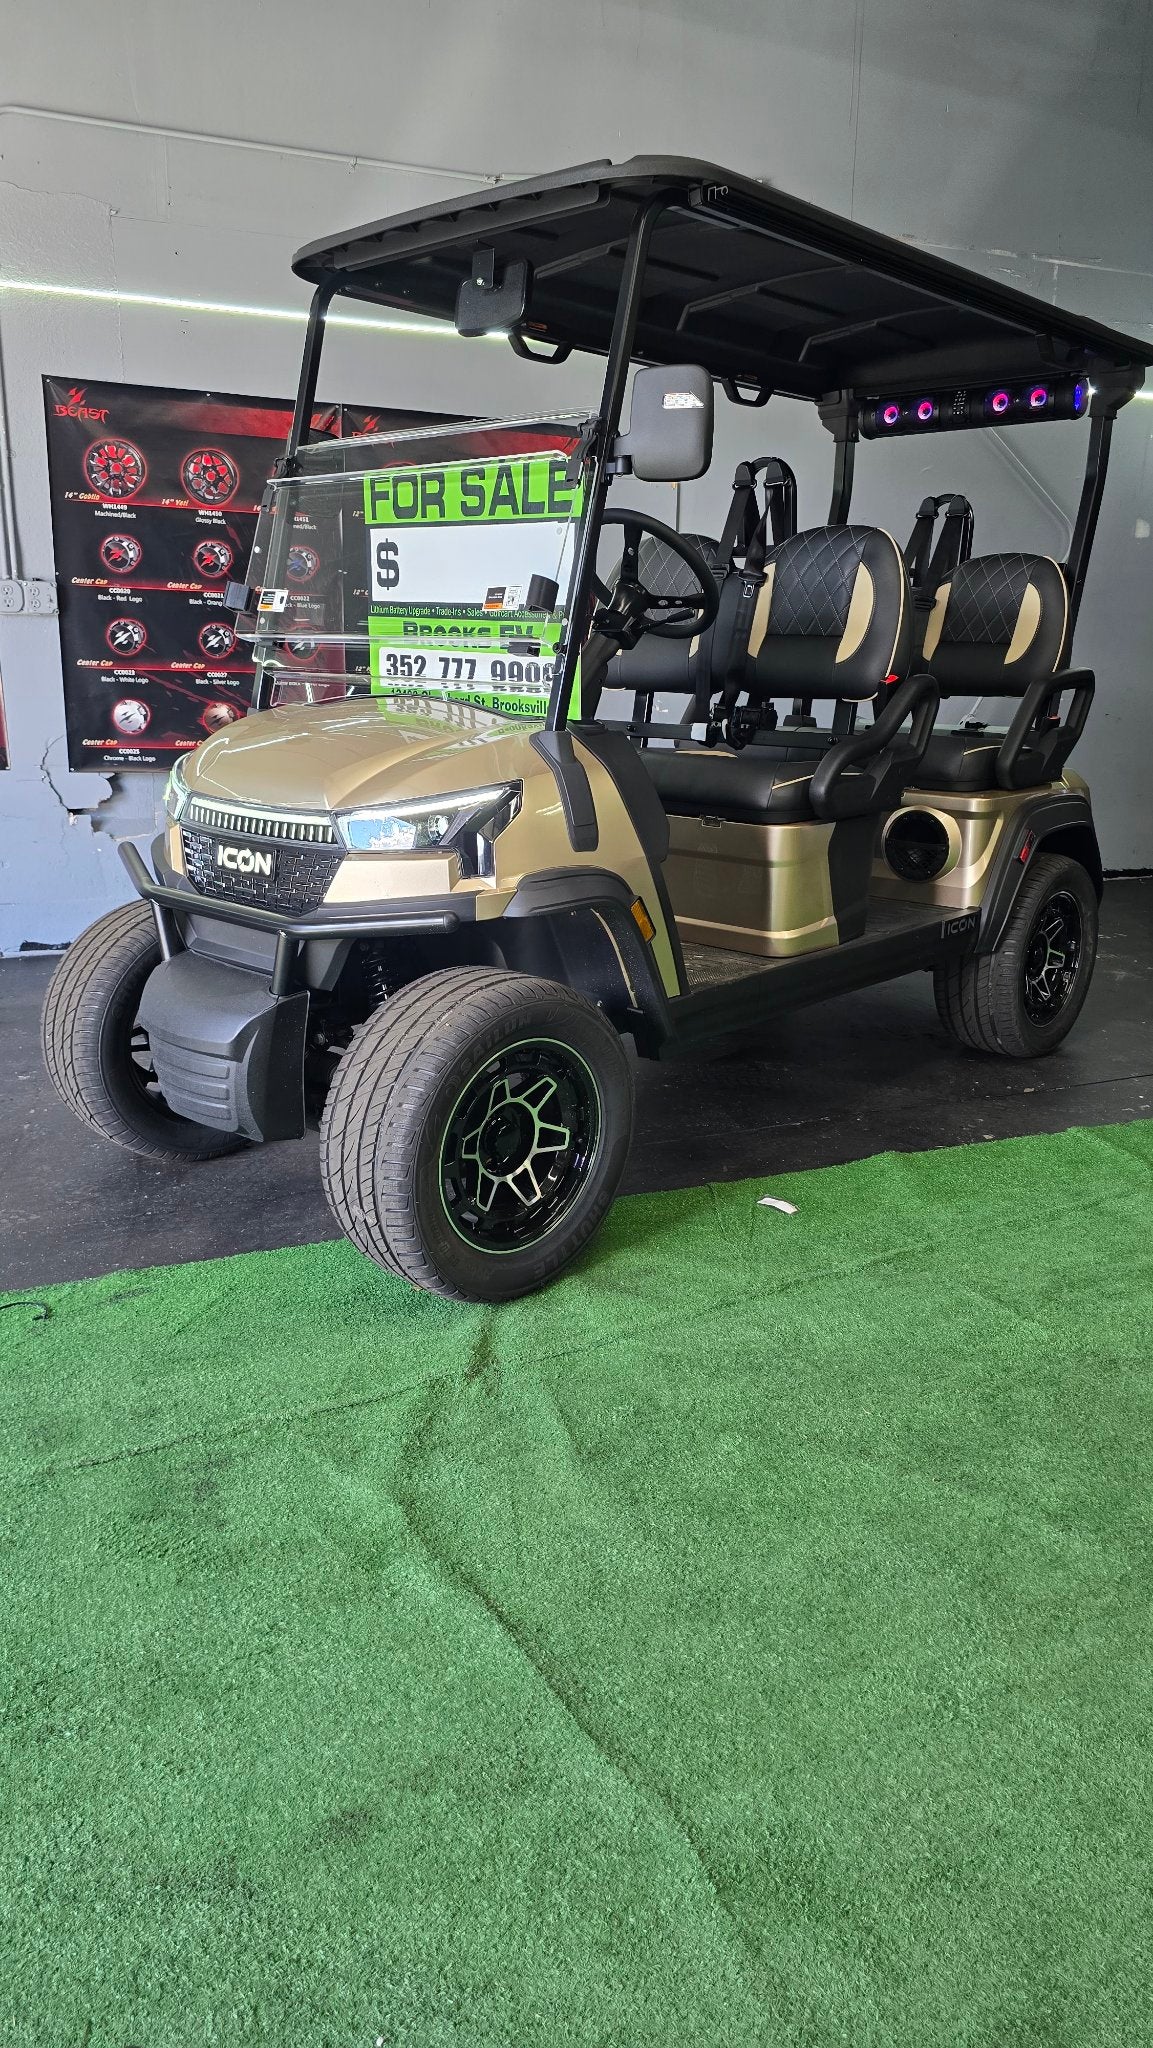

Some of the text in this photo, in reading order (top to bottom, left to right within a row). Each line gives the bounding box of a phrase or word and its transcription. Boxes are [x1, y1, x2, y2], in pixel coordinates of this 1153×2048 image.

[53, 404, 110, 424] BEAST
[370, 459, 573, 521] FOR SALE
[94, 510, 137, 519] Machined/Black
[376, 538, 400, 591] $
[71, 577, 95, 585] Center
[167, 582, 203, 590] Center Cap
[129, 596, 143, 604] Logo
[206, 599, 223, 607] Orang
[389, 606, 408, 616] Battery
[408, 606, 431, 616] Upgrade
[467, 607, 483, 616] Sales
[403, 620, 492, 648] BROOKS
[76, 659, 100, 667] Center
[170, 661, 206, 670] Center Cap
[386, 653, 427, 678] 352
[438, 657, 477, 680] 777
[226, 679, 240, 687] Logo
[492, 696, 547, 715] Brooksvill
[82, 738, 118, 747] Center Cap
[175, 739, 197, 747] Center
[217, 844, 272, 876] ICON
[946, 916, 977, 936] ICON
